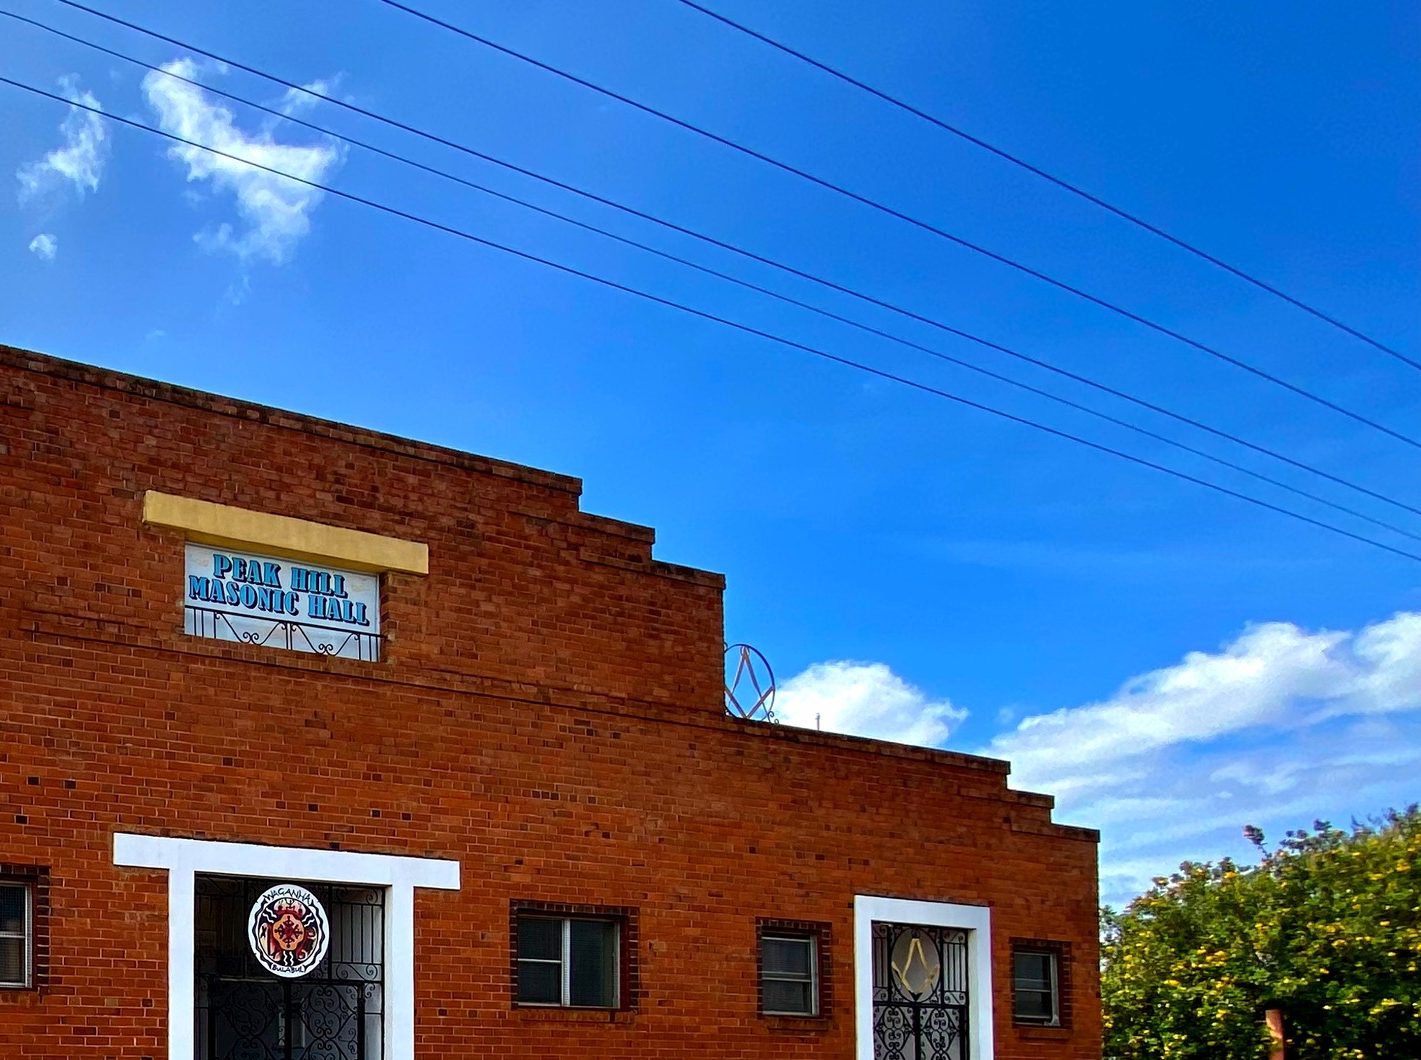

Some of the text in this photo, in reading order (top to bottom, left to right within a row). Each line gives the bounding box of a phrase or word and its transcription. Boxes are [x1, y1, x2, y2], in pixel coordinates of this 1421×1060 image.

[213, 554, 348, 598] PEAK HILL
[189, 575, 370, 627] MASONIC HALL
